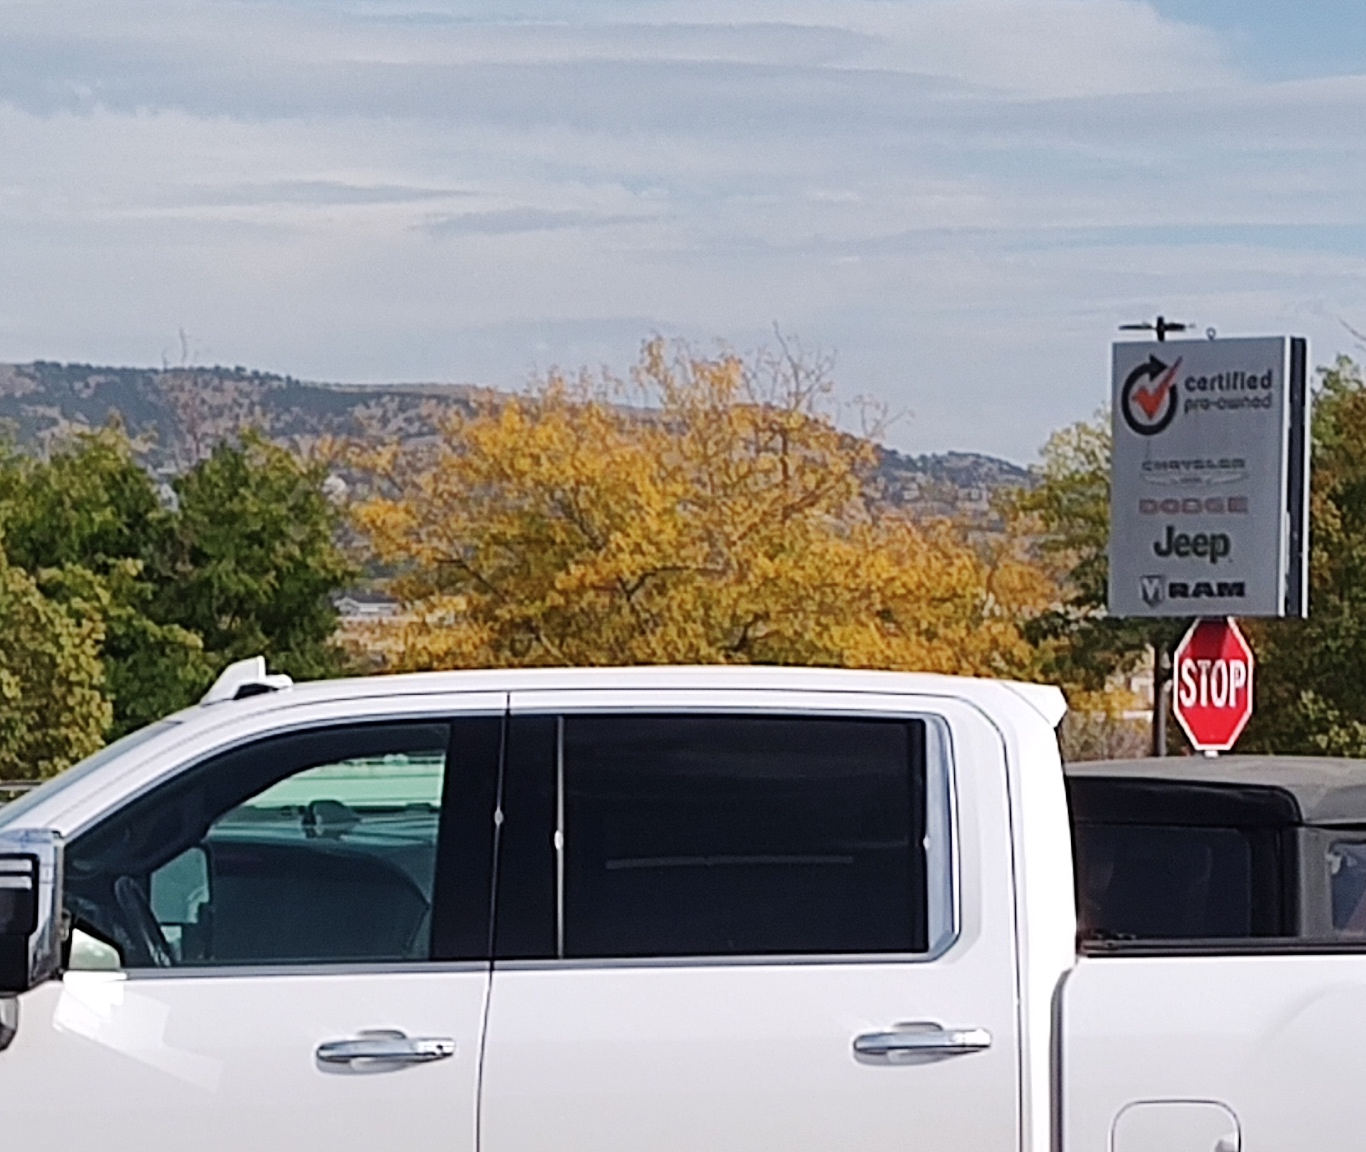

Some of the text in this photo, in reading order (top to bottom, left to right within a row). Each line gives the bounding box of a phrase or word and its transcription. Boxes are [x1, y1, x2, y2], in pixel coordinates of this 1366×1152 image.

[1185, 369, 1272, 392] certified
[1185, 393, 1272, 413] pre-owned
[1141, 458, 1245, 471] CHRYSLER
[1139, 497, 1248, 514] DODGE
[1153, 525, 1230, 565] Jeep
[1168, 582, 1245, 598] RAM
[1179, 658, 1246, 708] STOP
